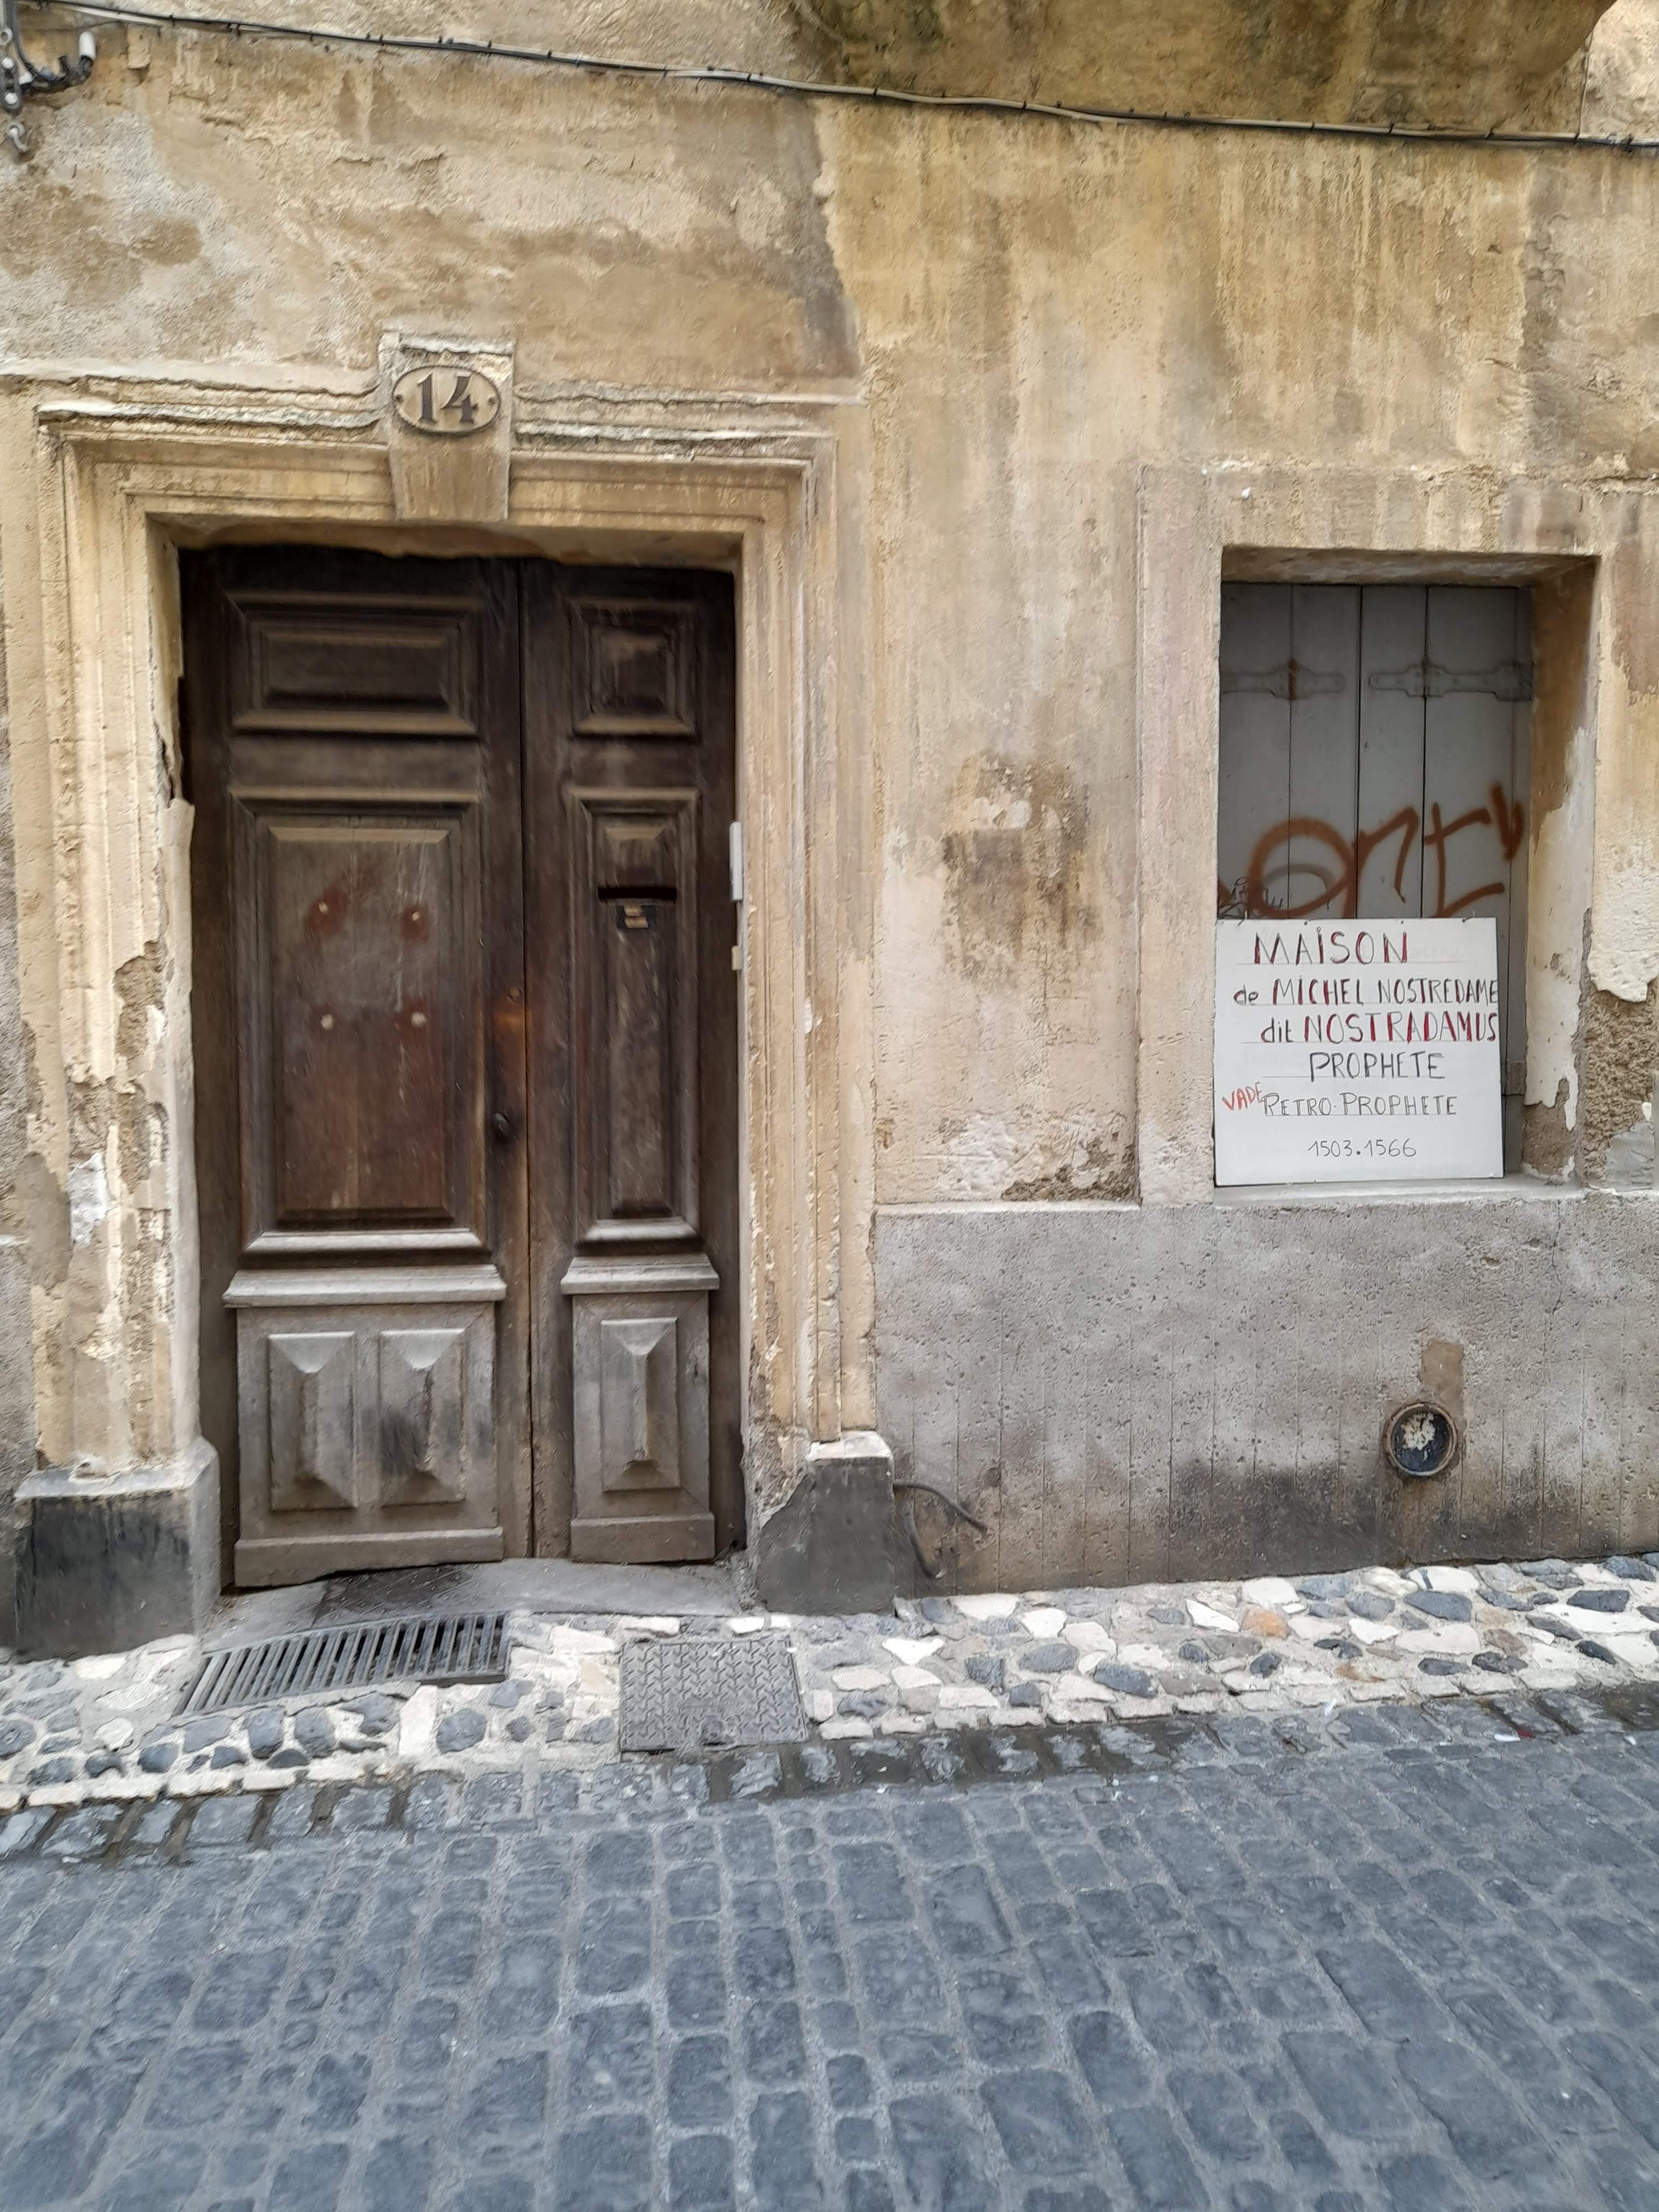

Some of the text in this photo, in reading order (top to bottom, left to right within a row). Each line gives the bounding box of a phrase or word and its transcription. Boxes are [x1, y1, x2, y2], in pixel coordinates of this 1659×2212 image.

[417, 372, 478, 424] 14
[1234, 975, 1498, 1006] de MICHEL NOSTREDAME
[1261, 1011, 1497, 1044] dit NOSTRADAMUS
[1310, 1051, 1445, 1082] PROPHETE
[1222, 1082, 1262, 1110] VADE
